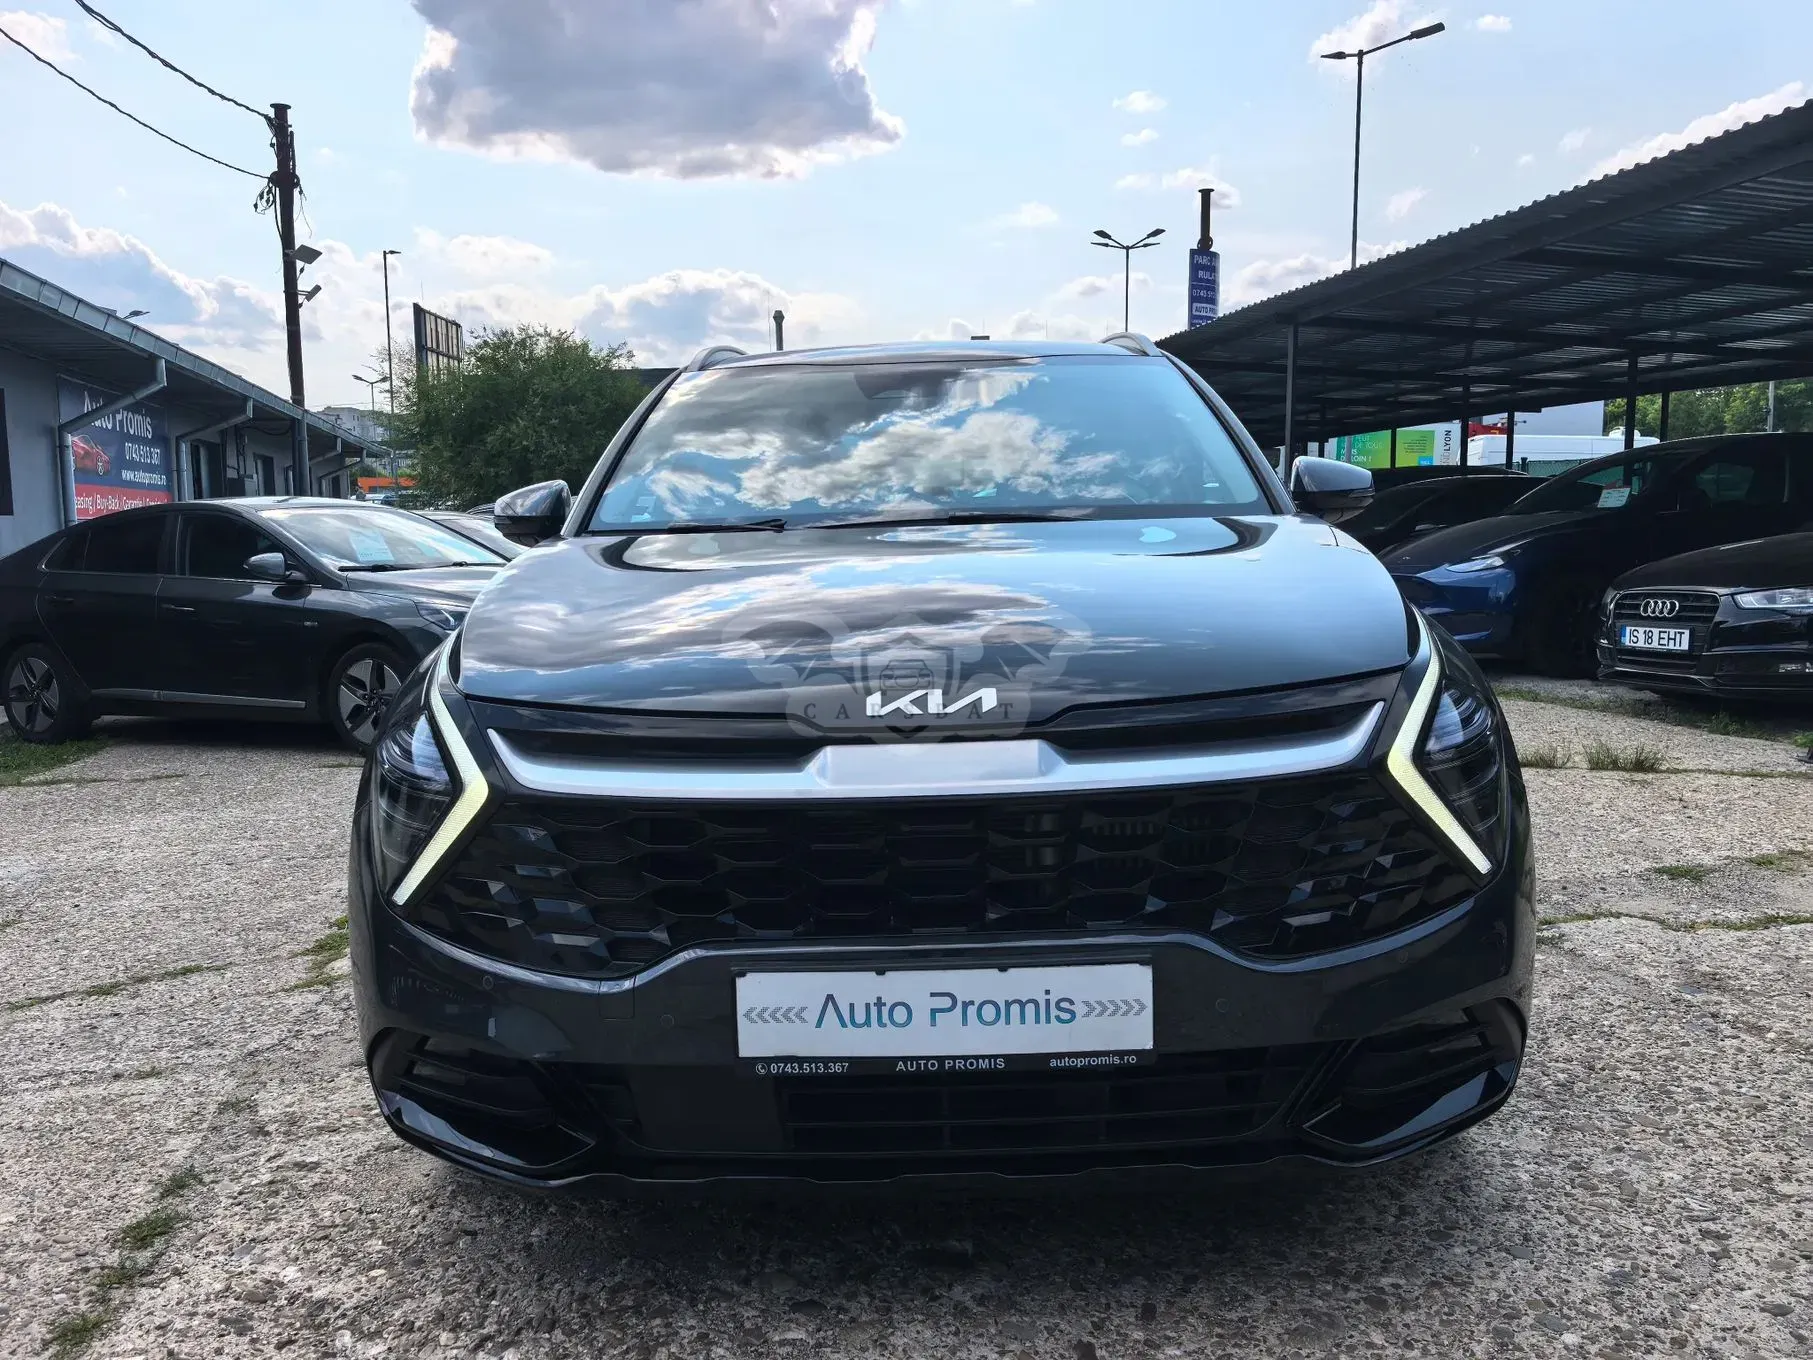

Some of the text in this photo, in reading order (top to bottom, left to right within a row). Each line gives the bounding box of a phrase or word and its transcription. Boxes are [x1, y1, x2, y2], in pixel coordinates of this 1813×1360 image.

[125, 442, 140, 462] 0743
[140, 446, 151, 464] 513
[75, 493, 93, 514] easing
[1628, 629, 1686, 648] IS 18 EHT
[814, 989, 1077, 1029] Auto Promis
[770, 1053, 1137, 1074] 0743.513.367 AUTO PROMIS autopromis.ro
